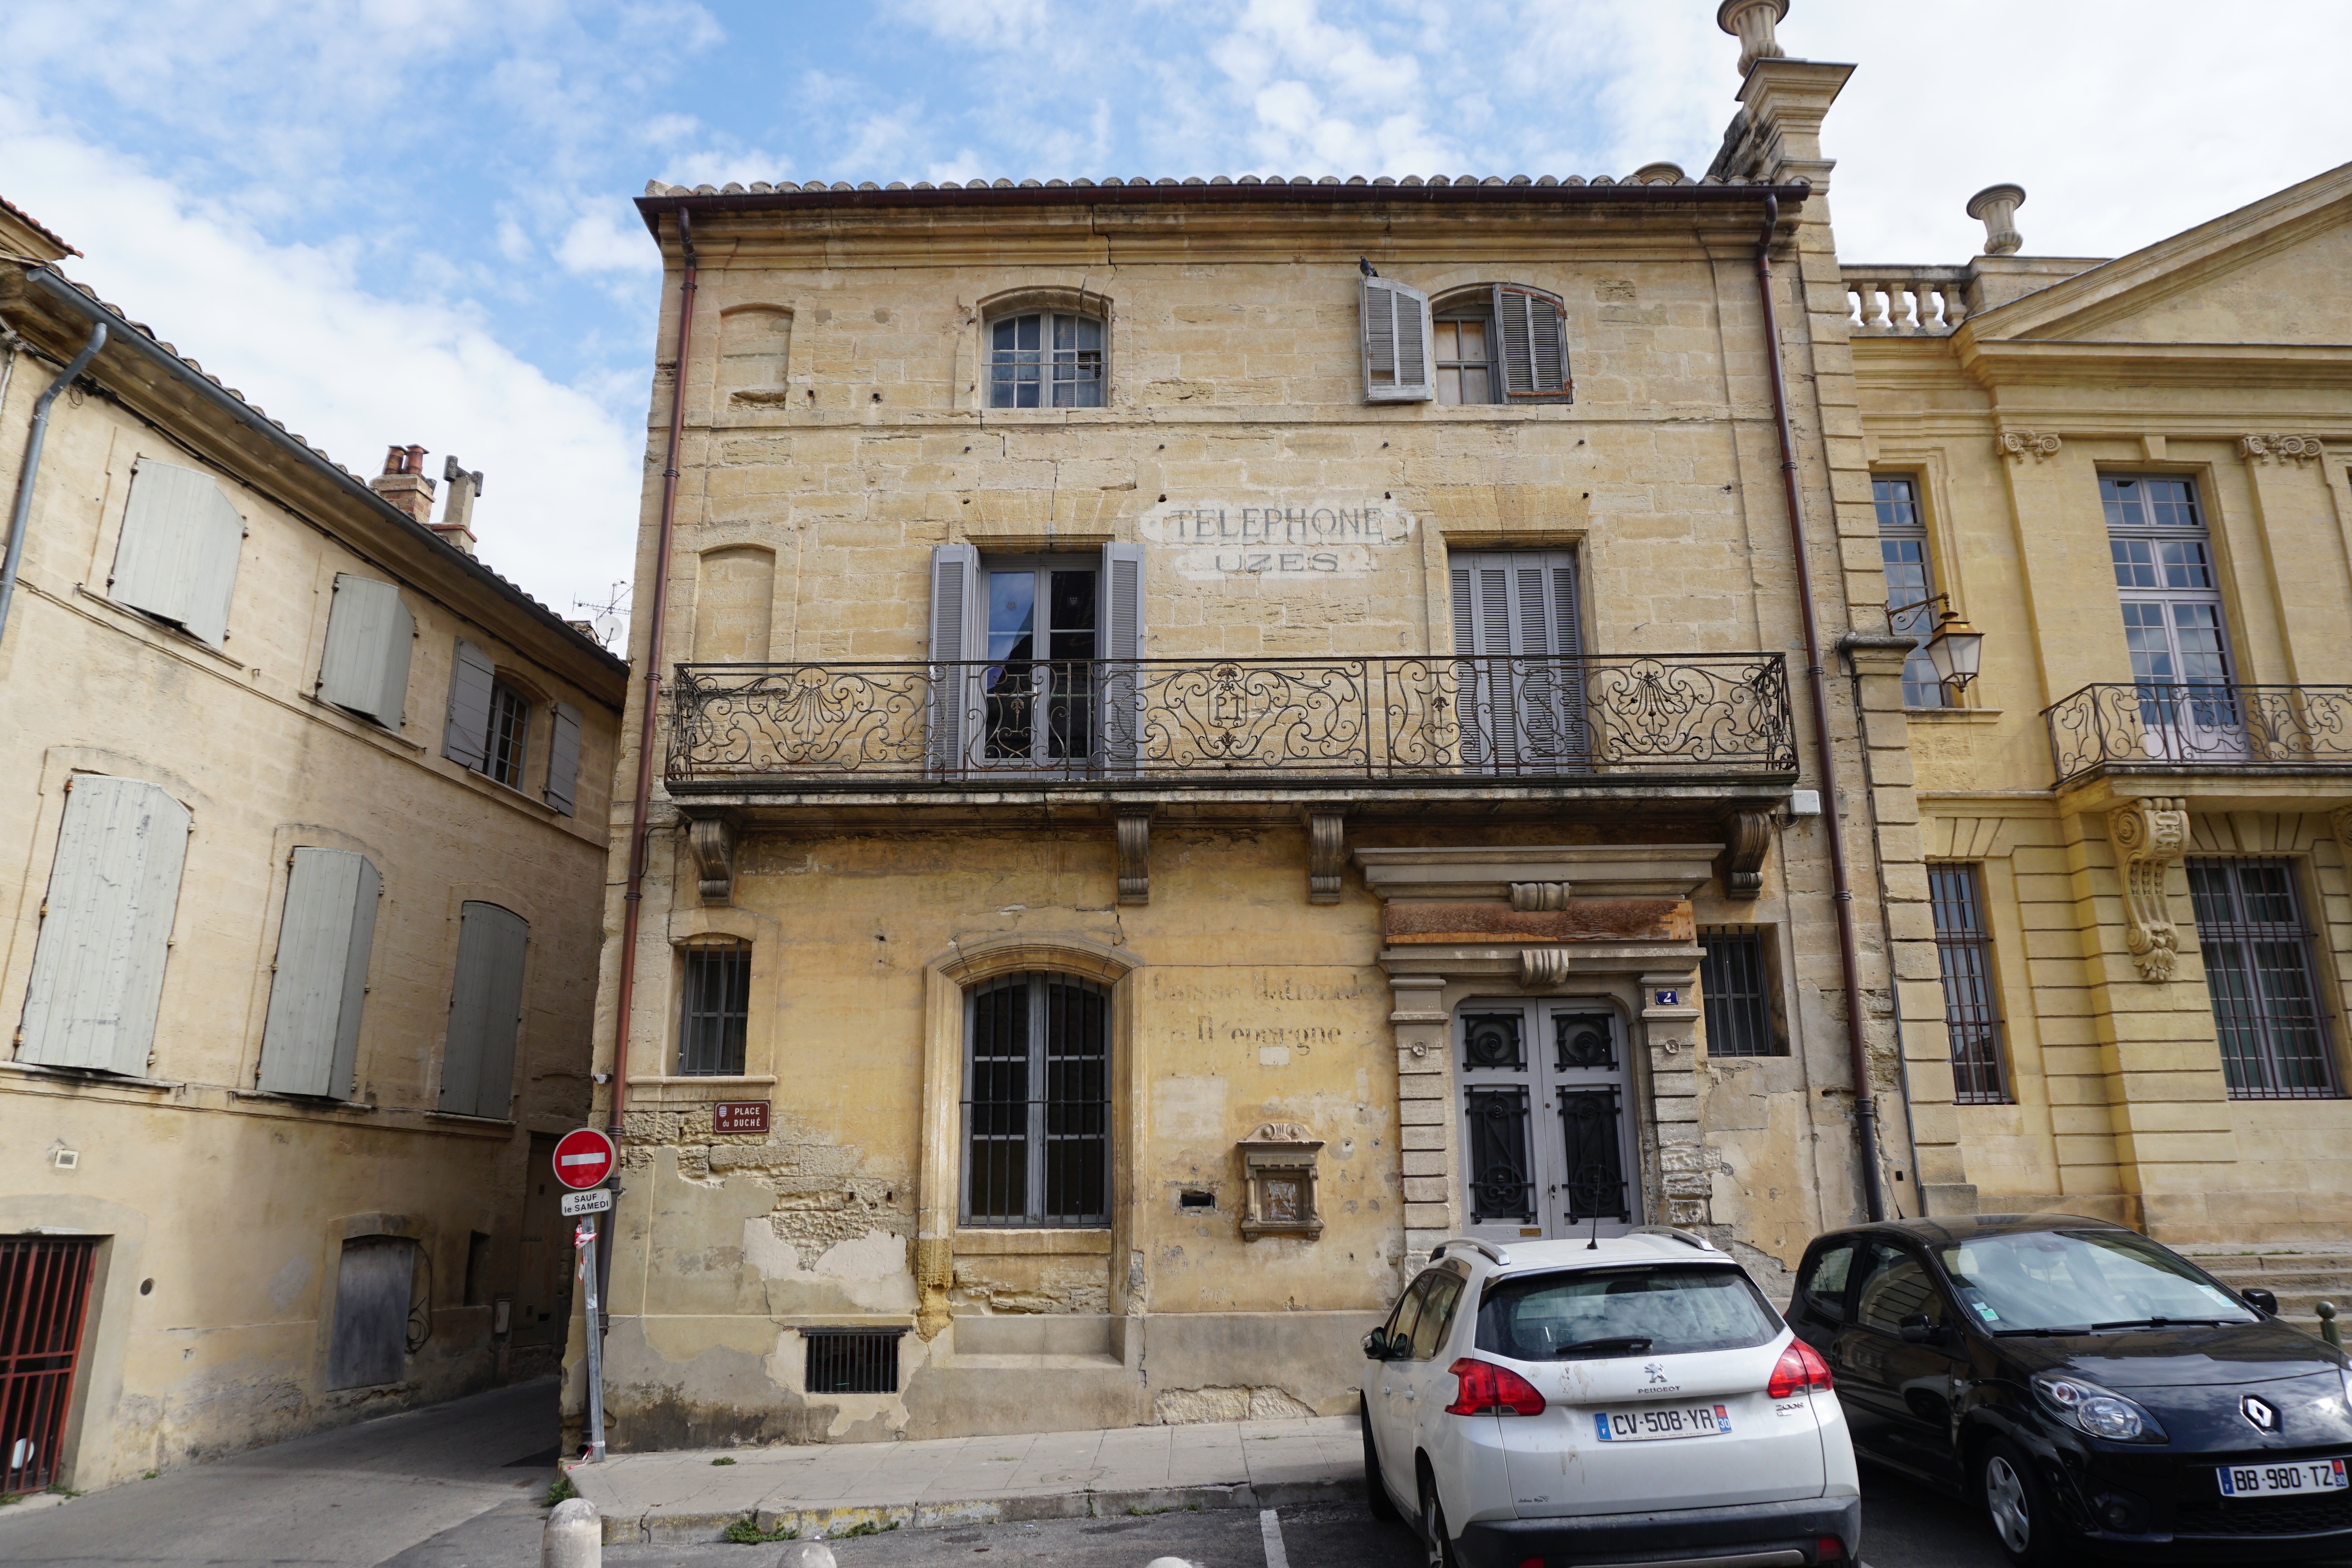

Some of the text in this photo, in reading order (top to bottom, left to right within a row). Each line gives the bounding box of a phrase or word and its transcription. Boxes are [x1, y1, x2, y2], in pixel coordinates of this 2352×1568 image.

[1170, 506, 1382, 537] TELEPHONE
[1215, 552, 1339, 571] UZES
[1663, 992, 1672, 1003] 2
[734, 1107, 760, 1115] PLACE
[734, 1117, 761, 1127] DUCHÉ
[574, 1193, 597, 1203] SAUF
[574, 1200, 609, 1212] SAMEDI
[1638, 1385, 1681, 1394] PEUGEOT
[1775, 1402, 1805, 1412] 2008
[1612, 1409, 1715, 1435] CV-508-YR
[1718, 1418, 1731, 1429] 30
[2233, 1465, 2334, 1492] BB-980-TZ
